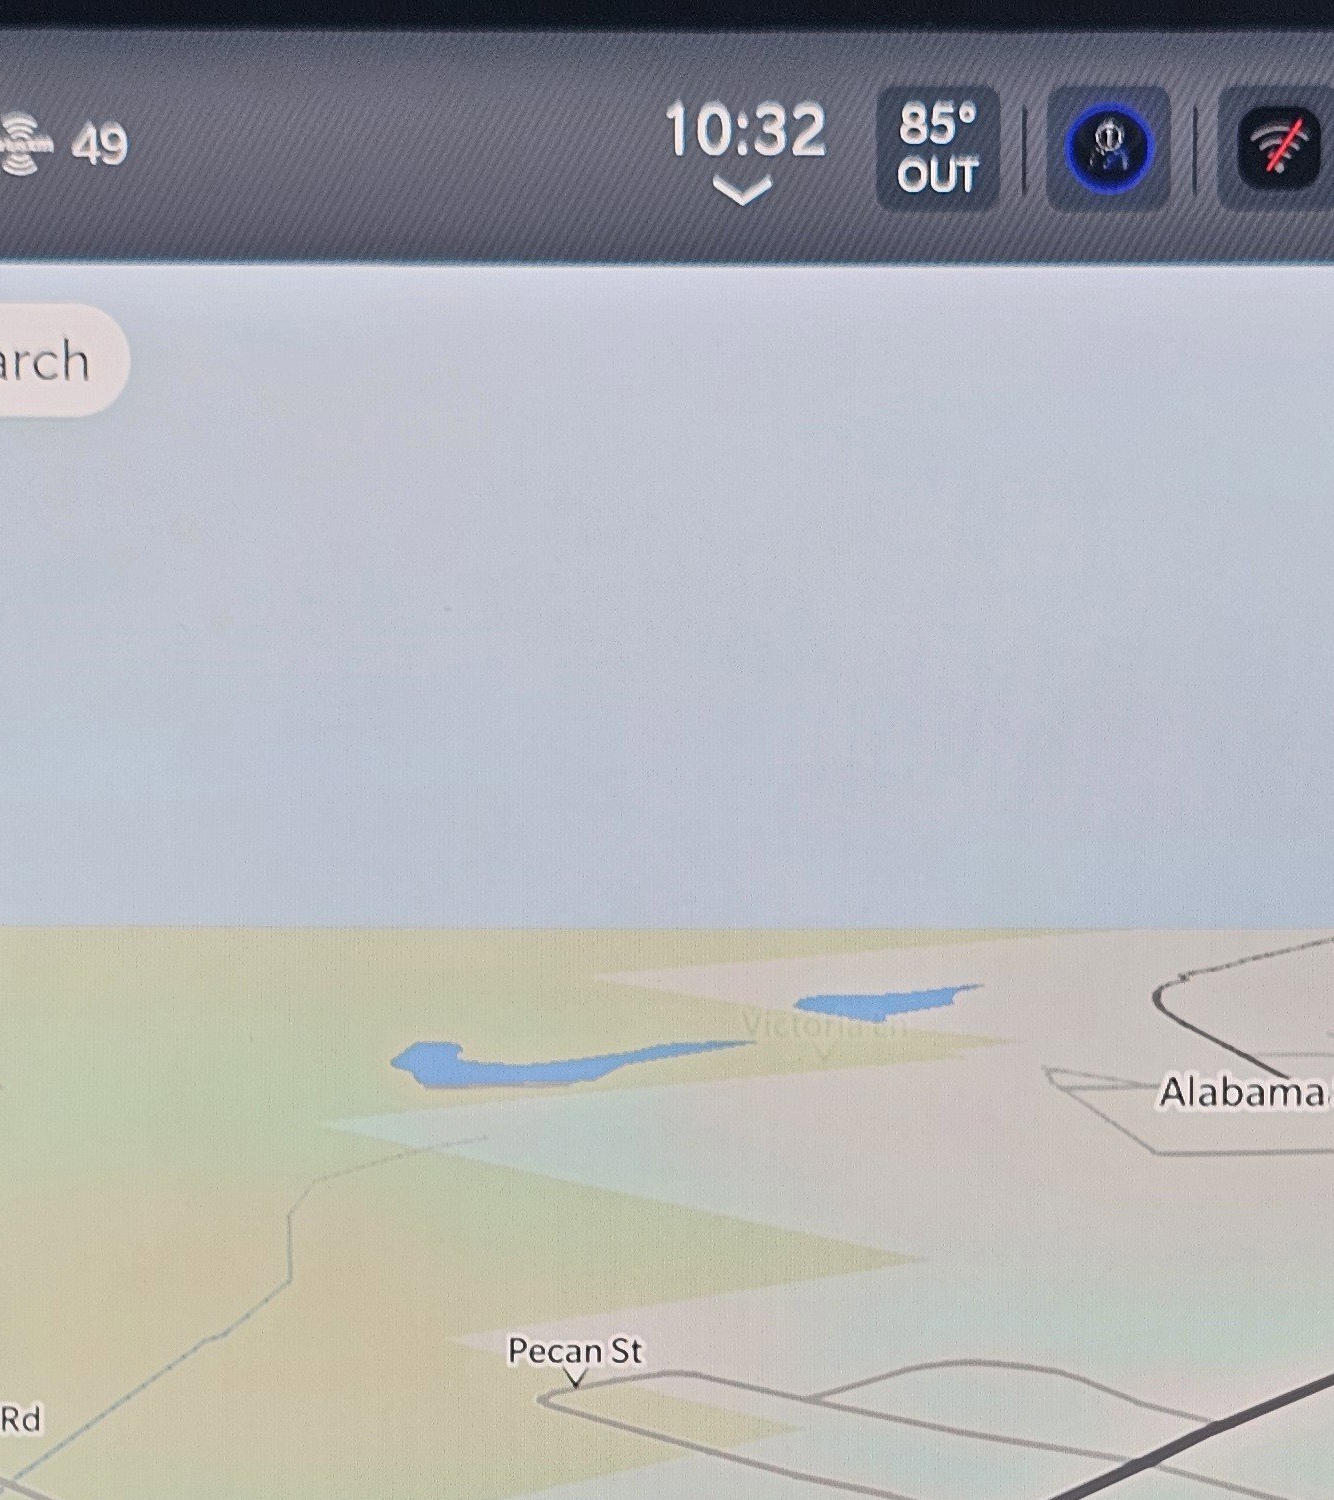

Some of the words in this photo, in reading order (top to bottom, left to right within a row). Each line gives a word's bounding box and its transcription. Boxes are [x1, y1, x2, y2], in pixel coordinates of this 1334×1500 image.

[71, 121, 128, 165] 49
[665, 101, 827, 157] 10:32
[897, 157, 981, 194] OUT
[1159, 1074, 1327, 1109] Alabama
[509, 1337, 603, 1364] Pecan
[611, 1337, 643, 1364] St
[1, 1405, 41, 1432] Rd
